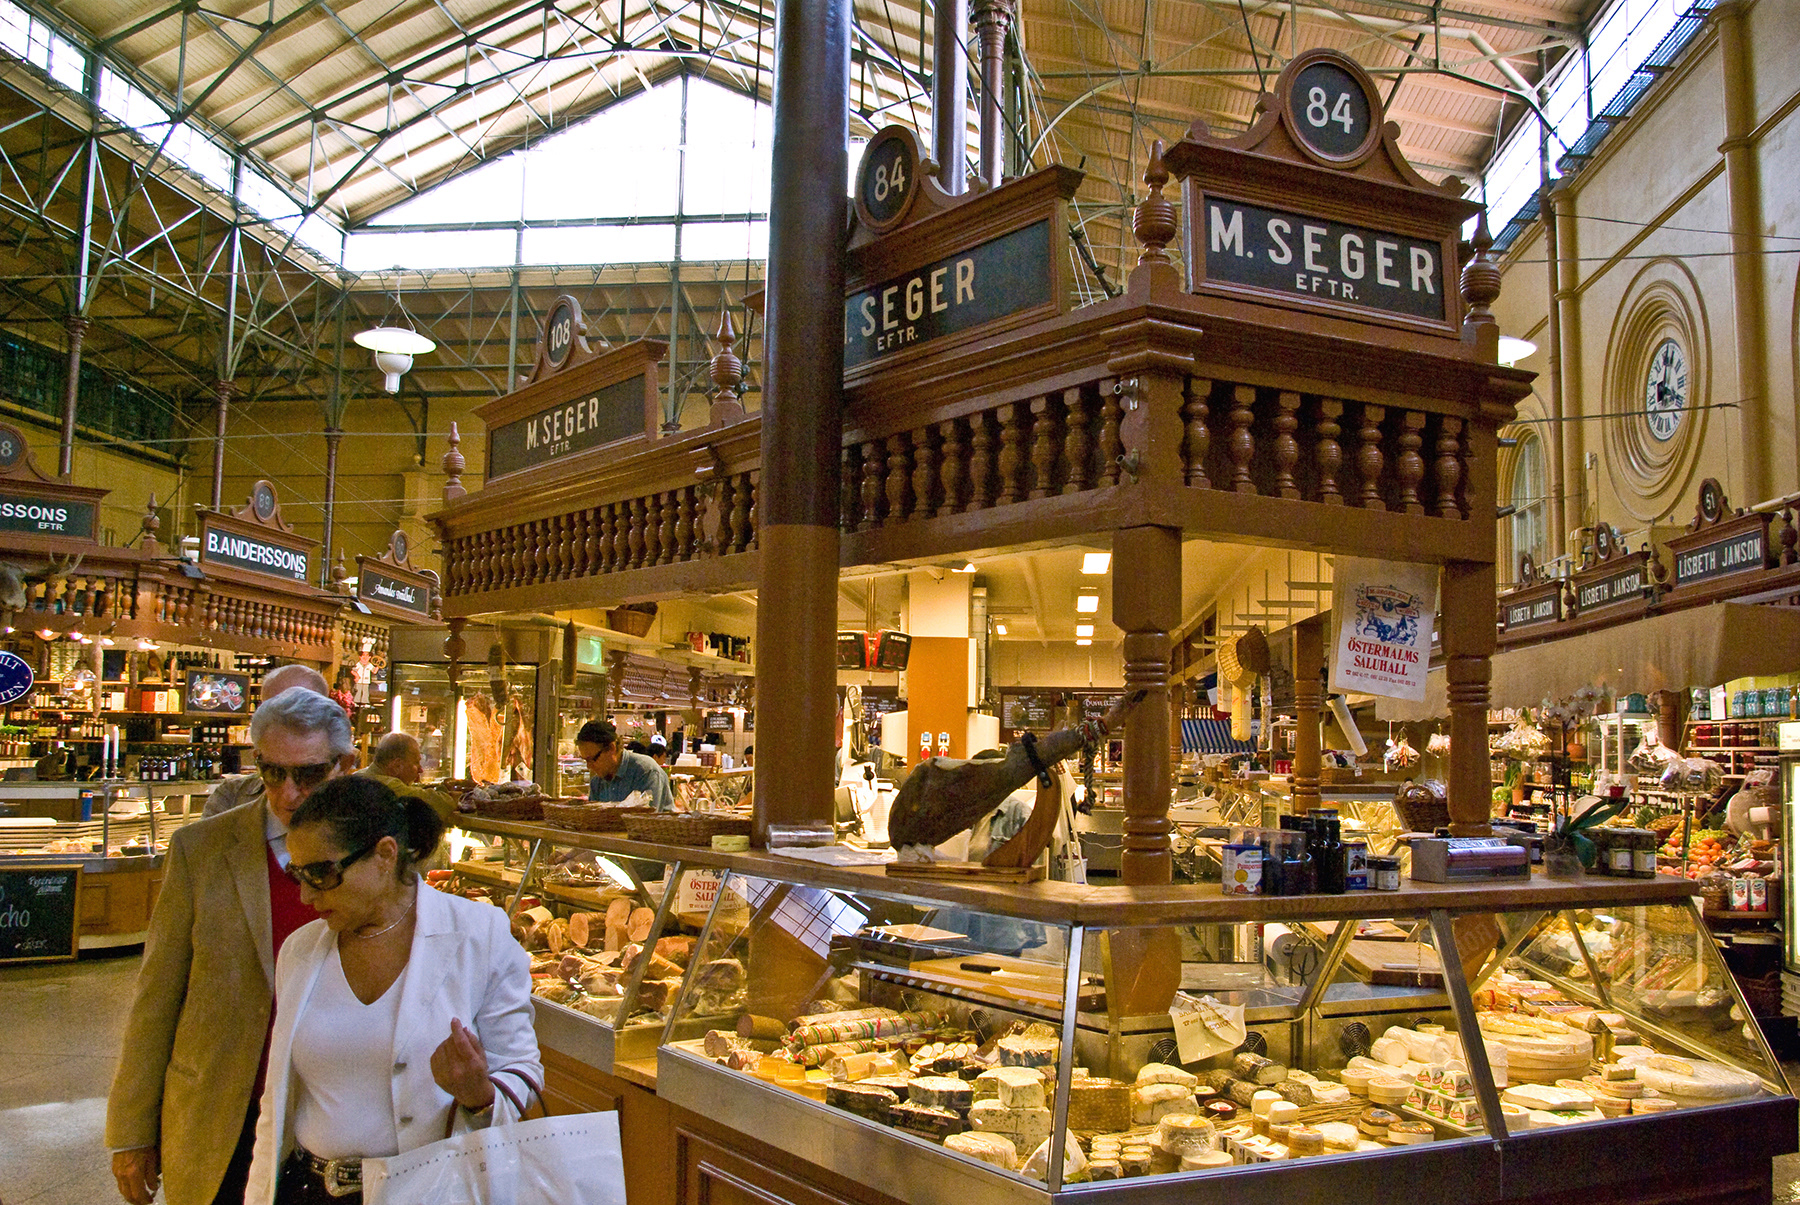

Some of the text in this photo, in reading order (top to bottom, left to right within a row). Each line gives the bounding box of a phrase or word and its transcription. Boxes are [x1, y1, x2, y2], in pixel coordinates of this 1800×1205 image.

[1306, 86, 1354, 134] 84
[874, 156, 906, 202] 84
[1210, 205, 1435, 295] M. SEGER
[861, 257, 976, 337] SEGER
[1296, 273, 1359, 300] EFTR.
[551, 318, 571, 352] 108
[877, 326, 919, 351] EFTR.
[542, 397, 599, 445] SEGER
[550, 440, 572, 455] EFTR.
[0, 502, 68, 522] SSONS
[1705, 492, 1716, 510] 51
[38, 521, 65, 532] EFTR.
[207, 532, 307, 573] B.ANDERSSONS
[1721, 537, 1761, 567] JANSON
[1612, 572, 1640, 598] JANSON
[1347, 637, 1419, 664] ÖSTERMALMS
[1353, 655, 1408, 676] SALUHALL
